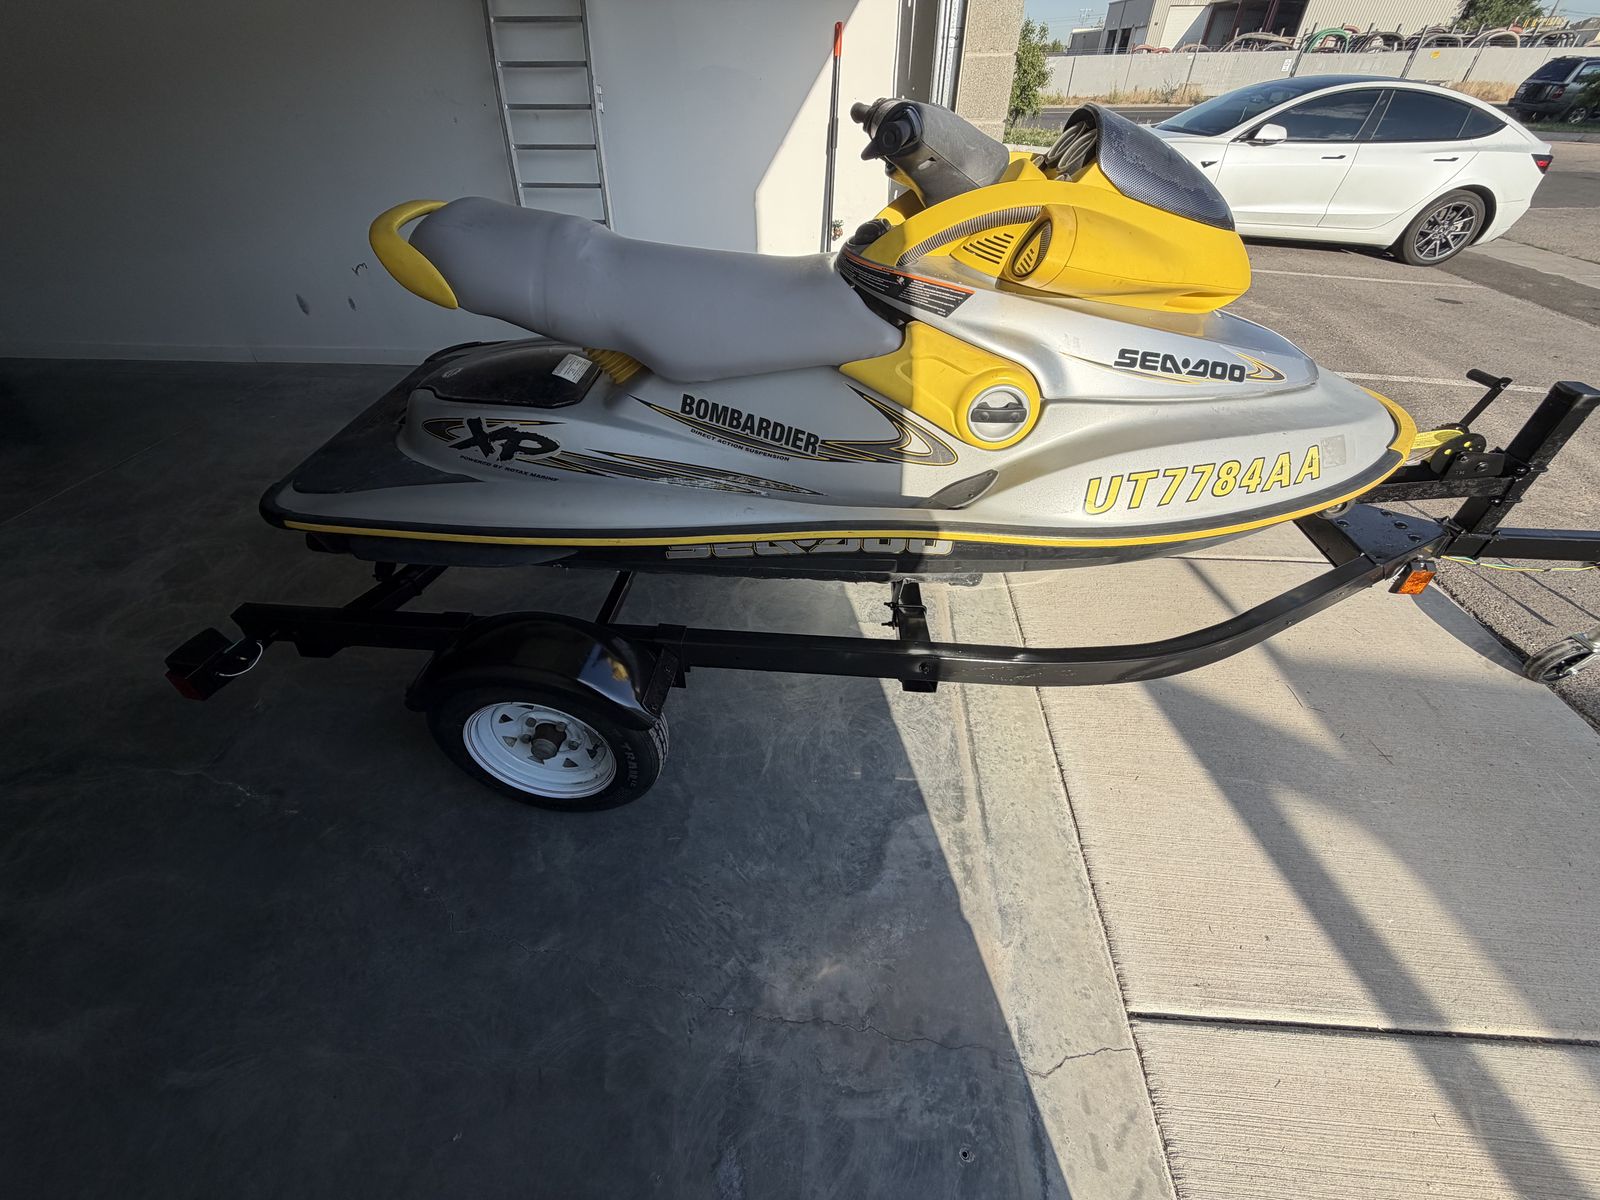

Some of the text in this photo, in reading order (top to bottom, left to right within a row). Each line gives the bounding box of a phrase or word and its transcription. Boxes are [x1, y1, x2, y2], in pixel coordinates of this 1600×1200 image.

[448, 416, 560, 462] XP
[680, 393, 821, 455] BOMBARDIER
[690, 428, 790, 462] DIRECT ACTION SUSPENSION
[504, 466, 529, 477] ROTAX
[1083, 444, 1321, 516] UT7784AA
